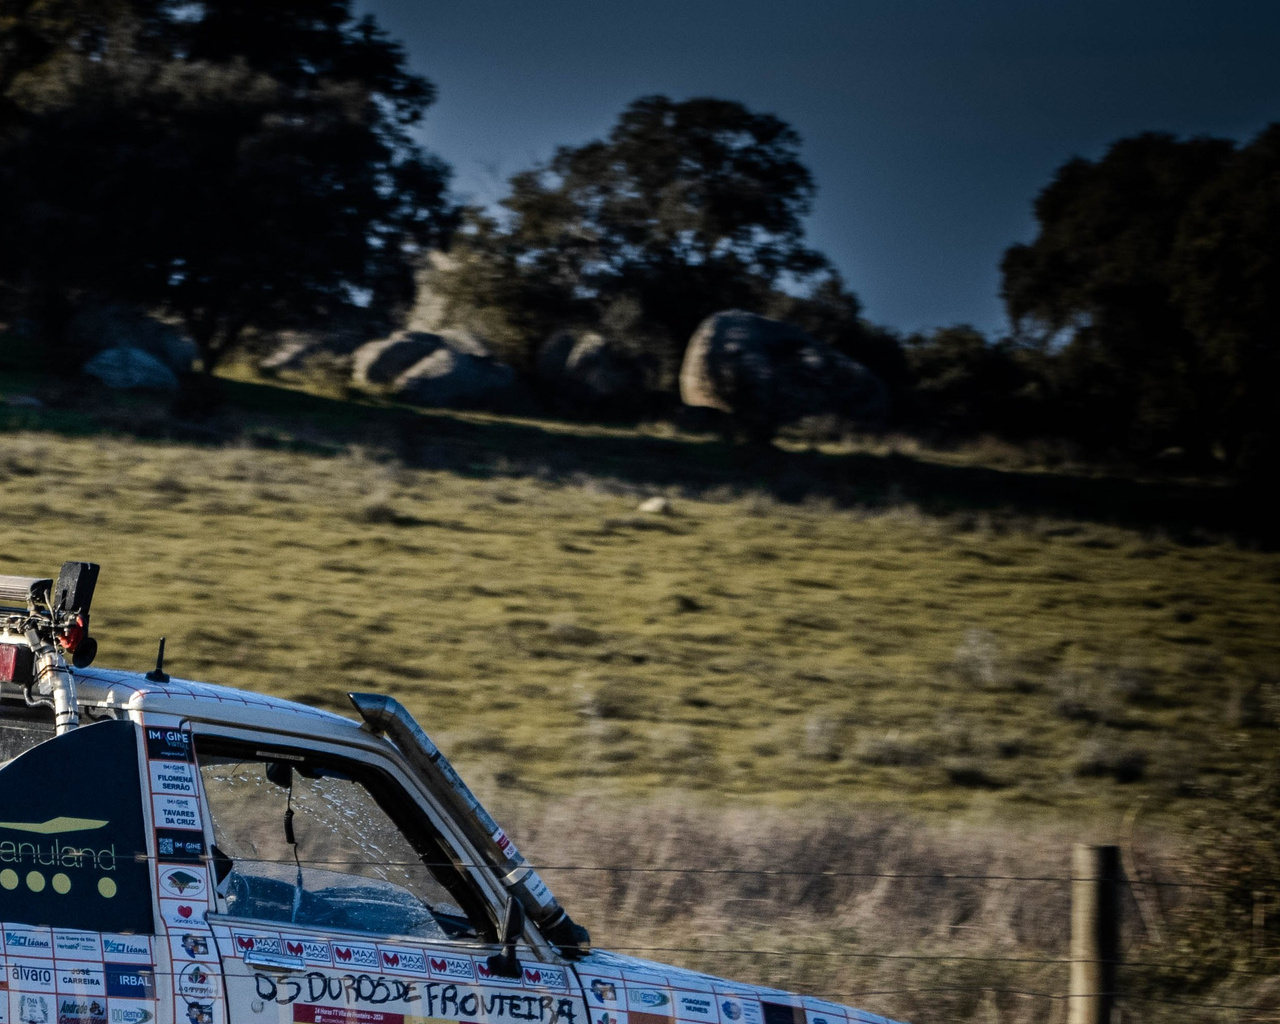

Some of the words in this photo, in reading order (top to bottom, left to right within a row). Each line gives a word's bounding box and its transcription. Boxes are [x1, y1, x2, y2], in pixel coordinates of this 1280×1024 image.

[158, 774, 193, 783] FILOMENA
[162, 782, 191, 791] SERRÃO
[163, 809, 194, 818] TAVARES
[165, 817, 175, 825] DA
[177, 818, 195, 826] CRUZ
[27, 935, 49, 948] Léana
[255, 939, 279, 948] MAXI
[125, 942, 148, 954] Léana
[303, 943, 328, 953] MAXI
[352, 949, 377, 959] MAXI
[399, 953, 423, 965] MAXI
[447, 960, 470, 970] MAXI
[71, 967, 91, 977] JOSÉ
[541, 971, 564, 980] MAXI
[62, 976, 101, 986] CARREIRA
[681, 996, 710, 1006] JOAQUIM
[60, 1000, 88, 1015] Andrade
[685, 1005, 708, 1014] NUNES
